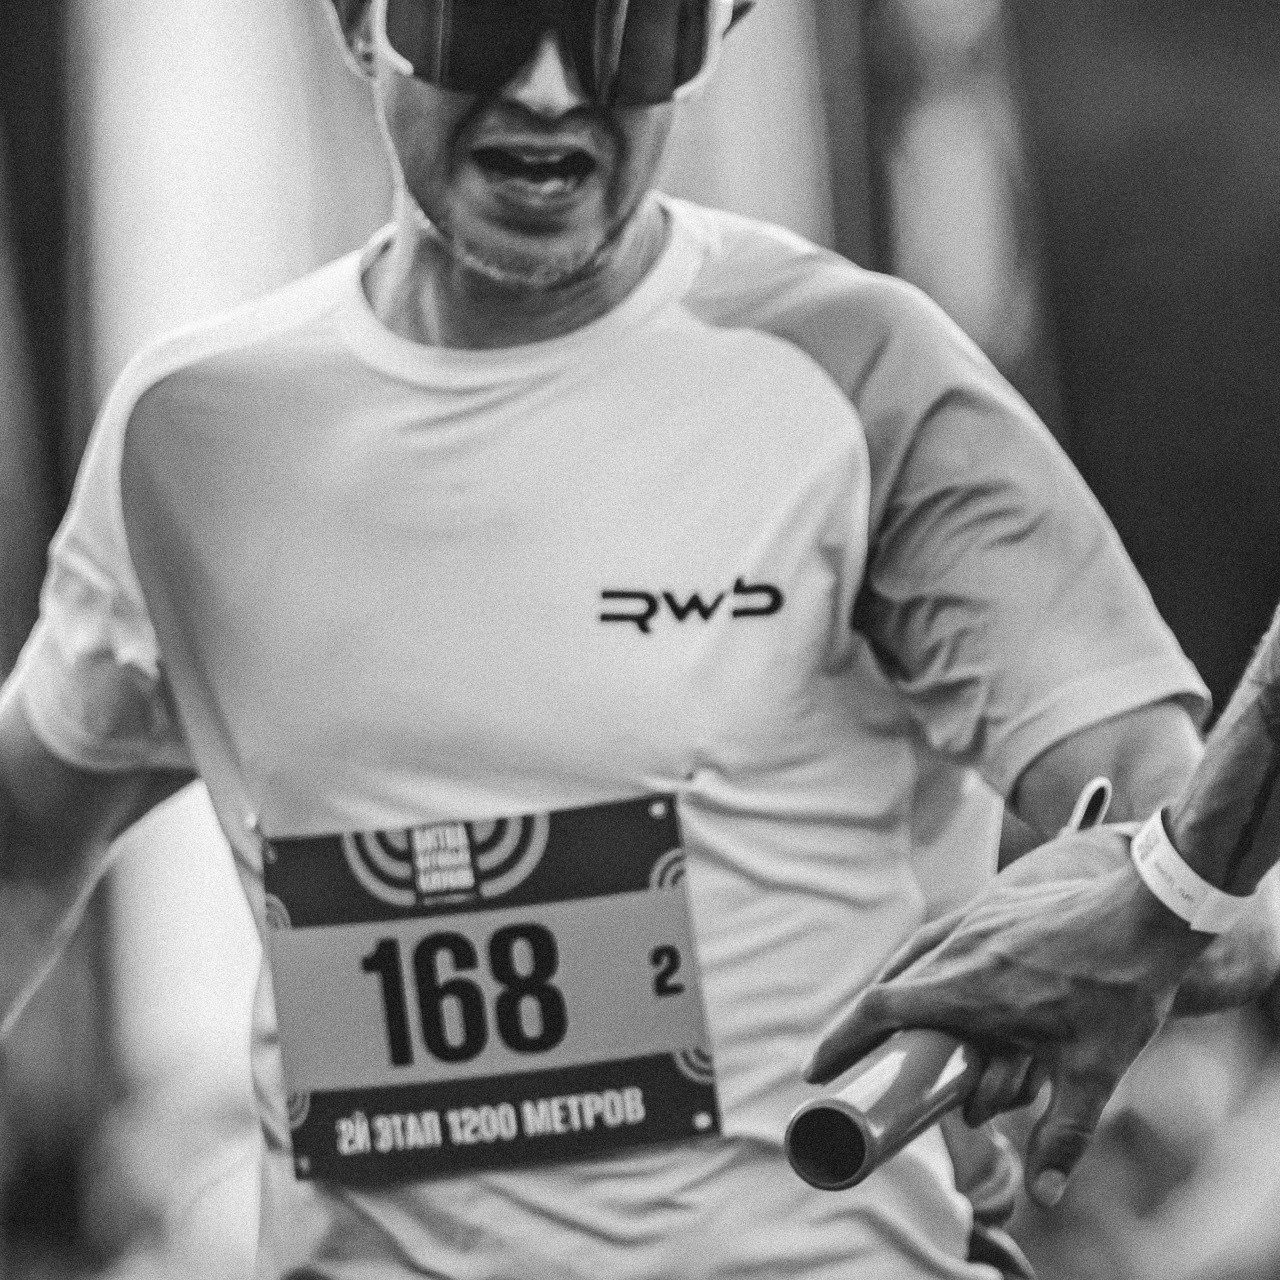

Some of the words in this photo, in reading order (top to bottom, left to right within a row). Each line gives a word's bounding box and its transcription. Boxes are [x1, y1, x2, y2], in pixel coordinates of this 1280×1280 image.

[361, 922, 570, 1067] 168
[649, 944, 686, 997] 2
[373, 1110, 443, 1153] ЭТАП
[447, 1101, 518, 1145] 1200
[521, 1086, 646, 1137] МЕТРОВ
